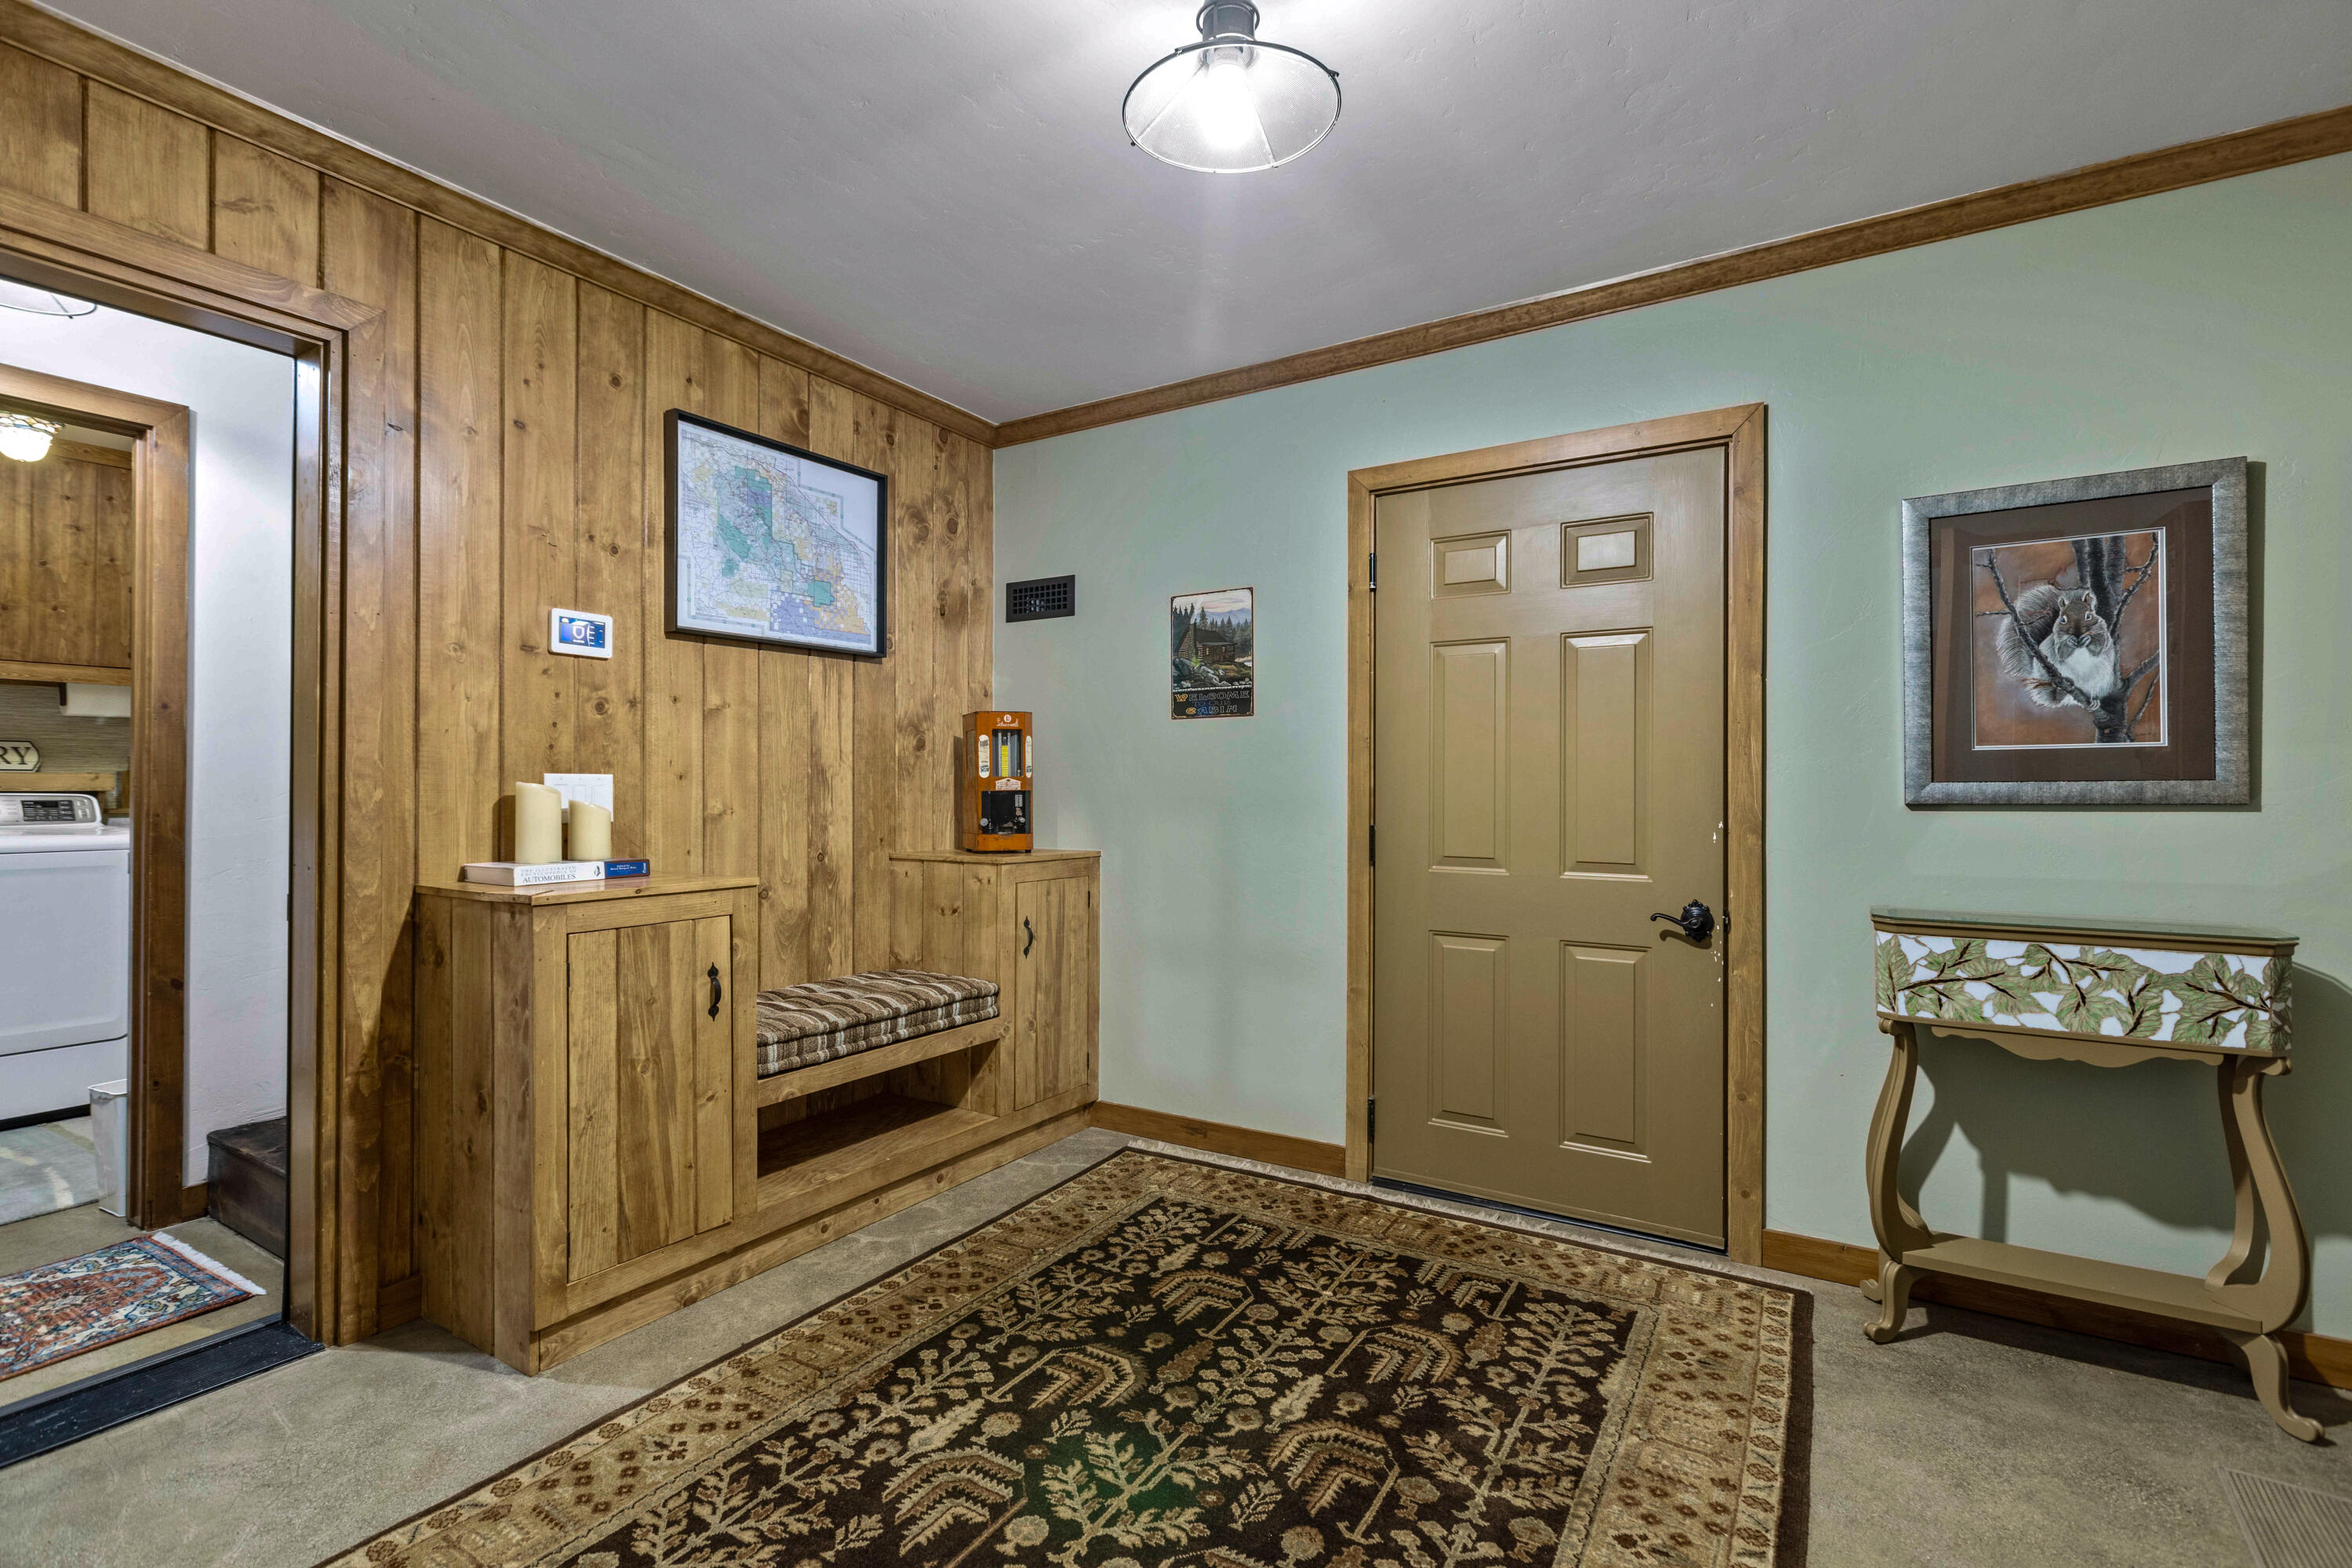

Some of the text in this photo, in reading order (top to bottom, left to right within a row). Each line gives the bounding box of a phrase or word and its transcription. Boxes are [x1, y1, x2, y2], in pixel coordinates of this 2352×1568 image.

[1174, 691, 1250, 702] WELCOME
[1185, 706, 1237, 714] CABIN
[522, 873, 576, 884] AUTOMOBILES
